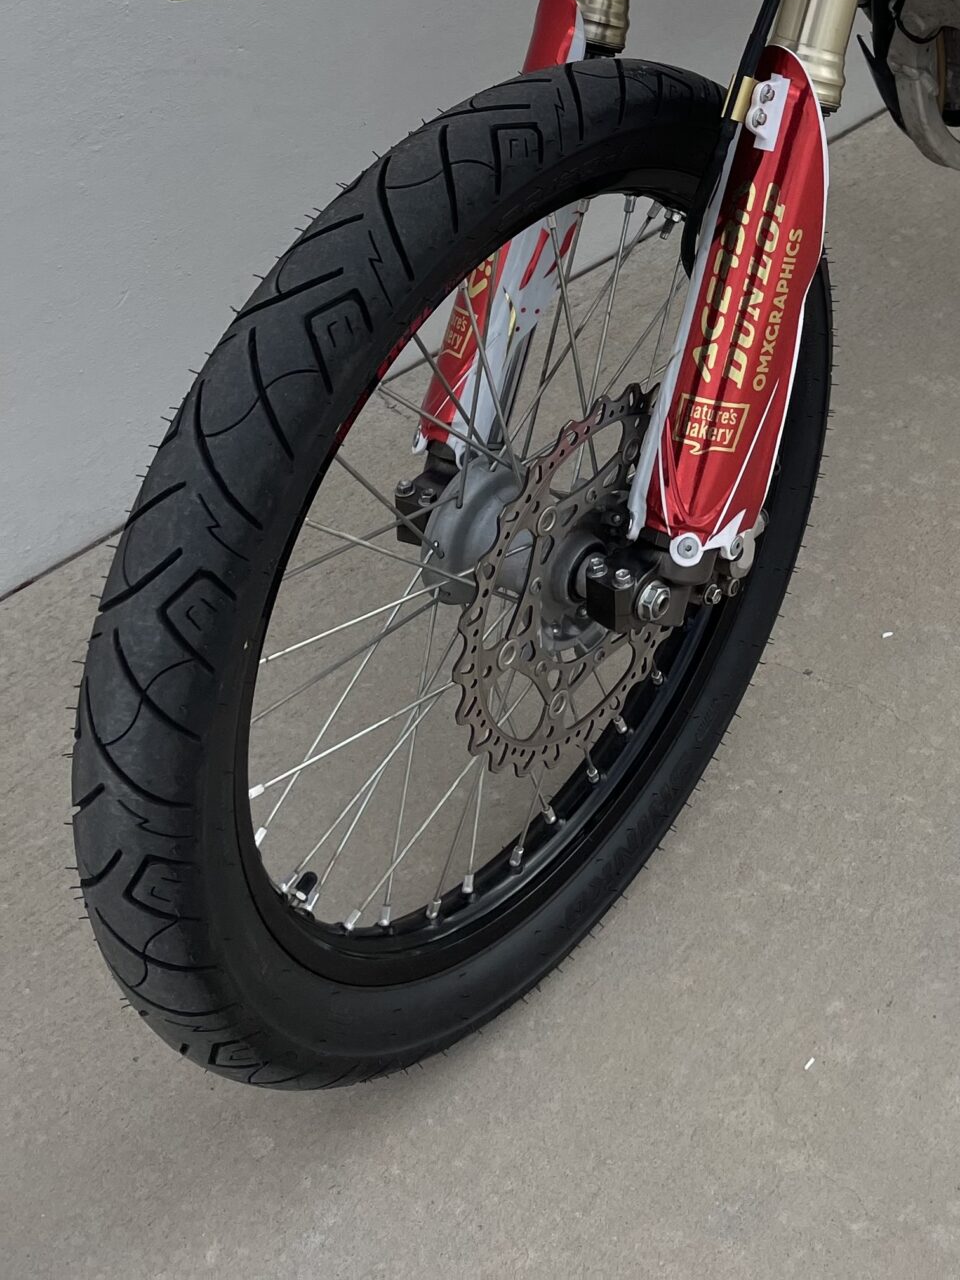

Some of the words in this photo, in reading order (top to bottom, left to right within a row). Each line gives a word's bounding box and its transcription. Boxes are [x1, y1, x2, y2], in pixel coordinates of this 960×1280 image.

[692, 182, 756, 384] ACERBIS
[721, 182, 786, 389] DUNLOP
[752, 228, 804, 392] OMXGRAPHICS
